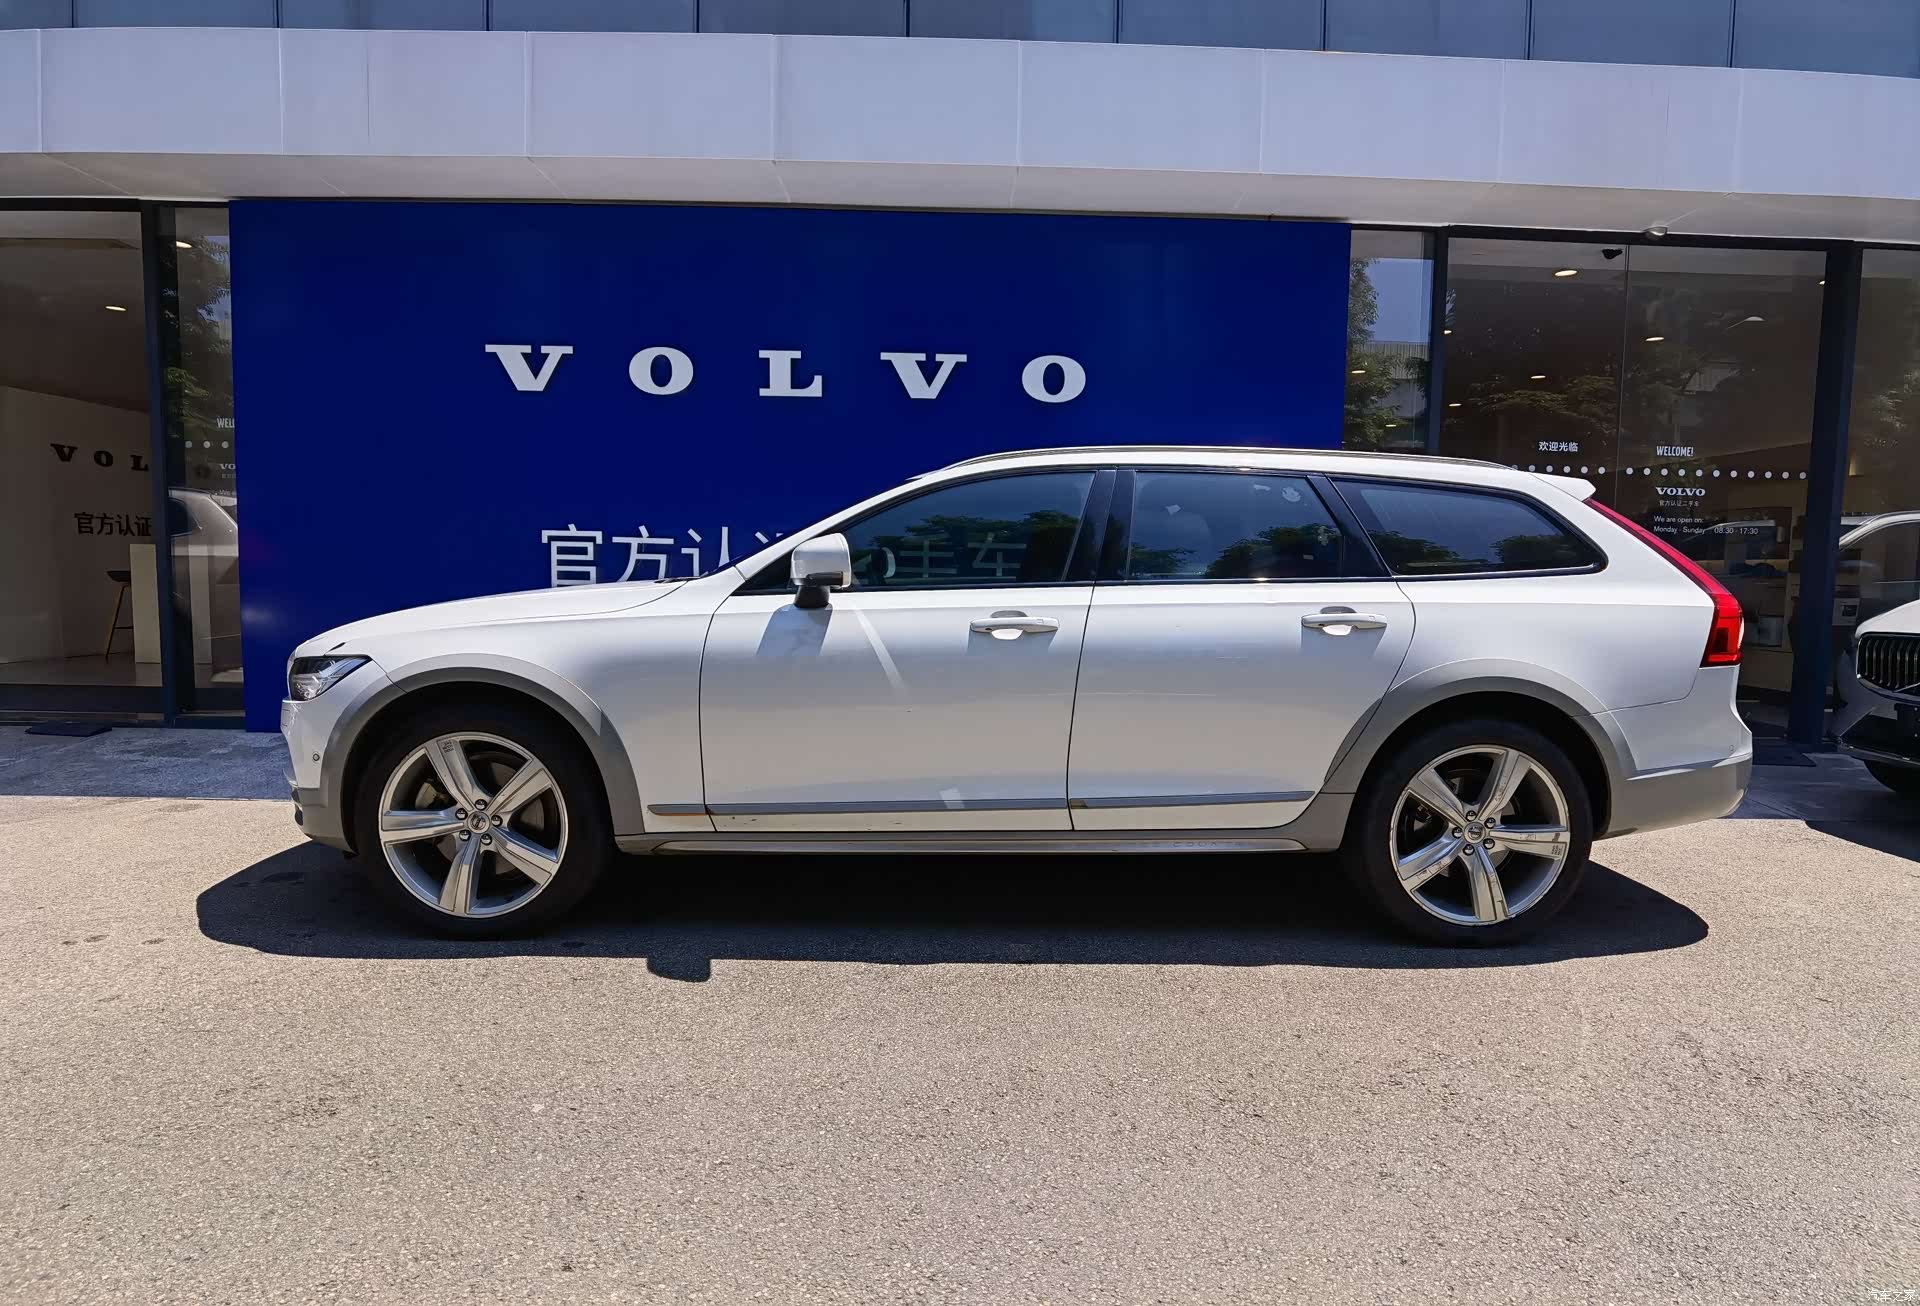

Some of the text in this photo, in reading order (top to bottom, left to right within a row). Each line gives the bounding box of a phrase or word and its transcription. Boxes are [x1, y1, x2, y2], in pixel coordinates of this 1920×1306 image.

[484, 343, 1087, 405] VOLVO
[1538, 441, 1579, 452] 欢迎光临
[1656, 445, 1694, 457] WELCOME!
[1656, 487, 1706, 497] VOLVO
[1653, 515, 1664, 523] We
[1677, 517, 1693, 525] open
[1653, 525, 1678, 534] Monday
[1682, 526, 1706, 535] Sunday
[1713, 527, 1734, 535] 08:30
[1739, 527, 1759, 535] 17:30
